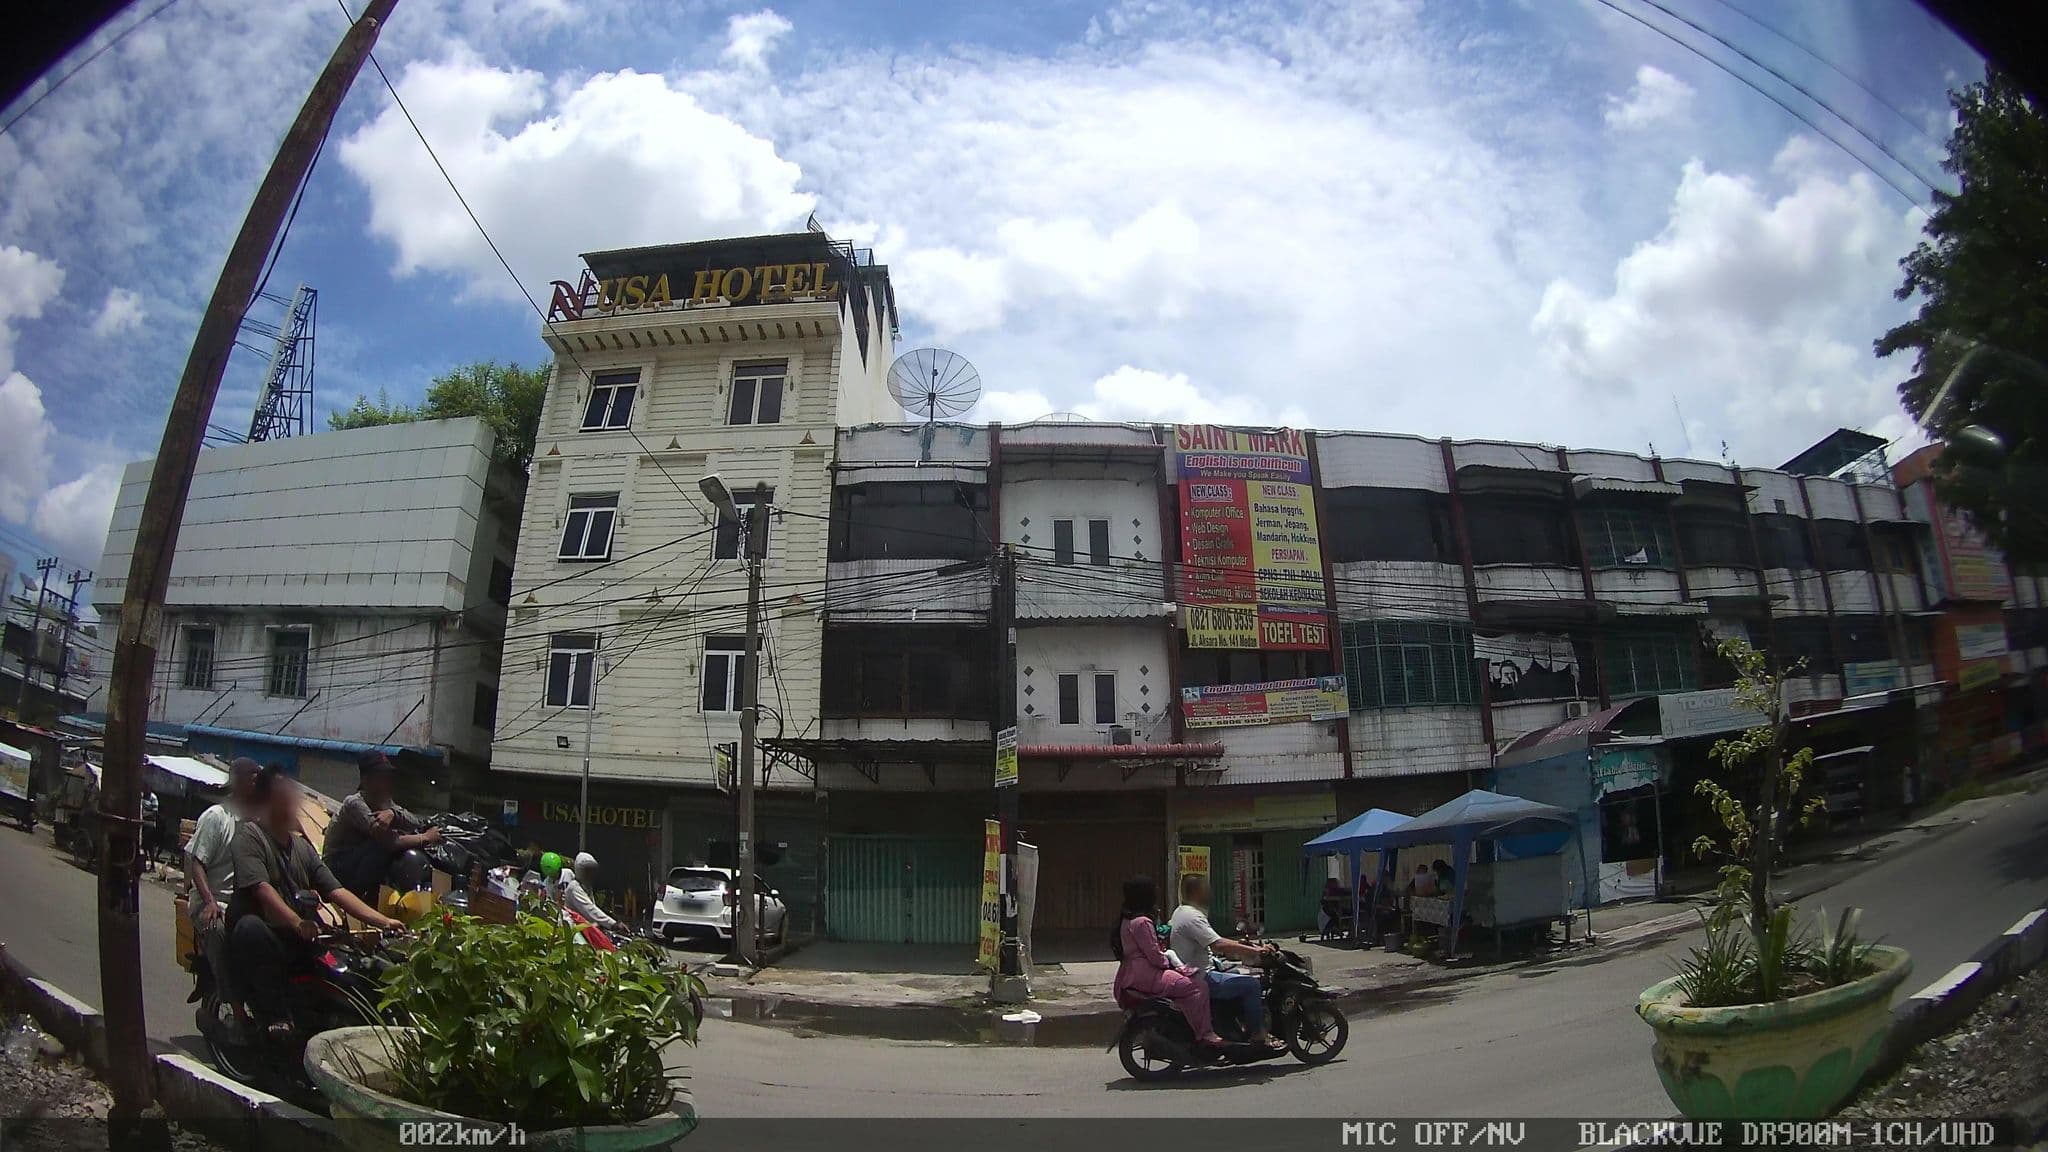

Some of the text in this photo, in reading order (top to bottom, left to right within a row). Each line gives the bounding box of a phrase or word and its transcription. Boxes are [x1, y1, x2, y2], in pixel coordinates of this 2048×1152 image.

[689, 263, 839, 304] HOTEL
[1178, 424, 1306, 456] SAINT MARK
[1185, 455, 1302, 472] English is not Difficult
[1214, 470, 1232, 478] Make
[1191, 485, 1206, 497] NEW
[1262, 485, 1277, 496] NEW
[1191, 507, 1221, 519] Komputer
[1225, 506, 1243, 518] Office
[1254, 503, 1304, 516] Bahasa Inggris,
[1191, 522, 1229, 535] Web Design
[1256, 518, 1309, 531] Jerman, Jepang,
[1256, 532, 1317, 544] Mandarin, Hokkien
[1193, 554, 1248, 567] Teknisi Komputer
[1190, 608, 1209, 631] 0821
[1262, 622, 1326, 644] TOEFL TEST
[587, 805, 661, 829] HOTEL
